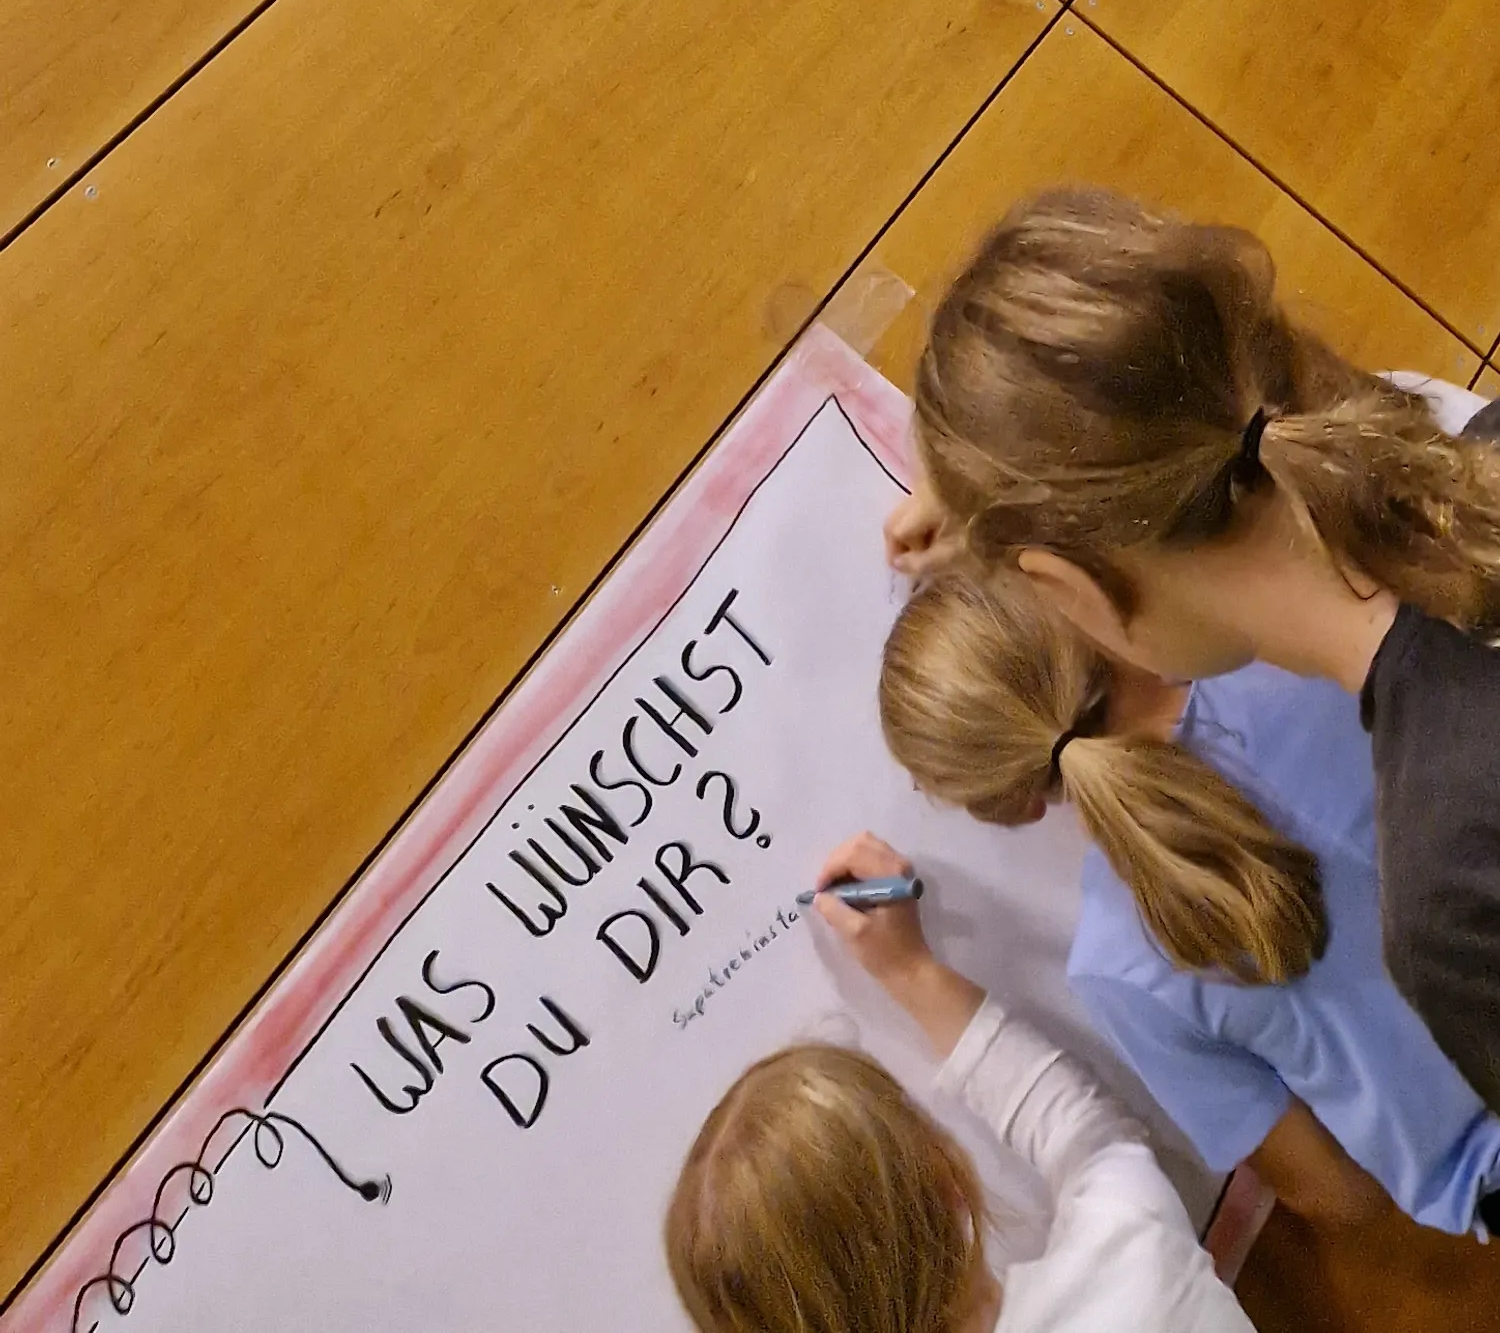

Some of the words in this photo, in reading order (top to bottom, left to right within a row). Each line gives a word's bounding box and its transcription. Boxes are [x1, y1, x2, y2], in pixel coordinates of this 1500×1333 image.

[350, 950, 495, 1114] WAS
[486, 589, 772, 937] WÜNSCHST
[480, 996, 590, 1129] DU
